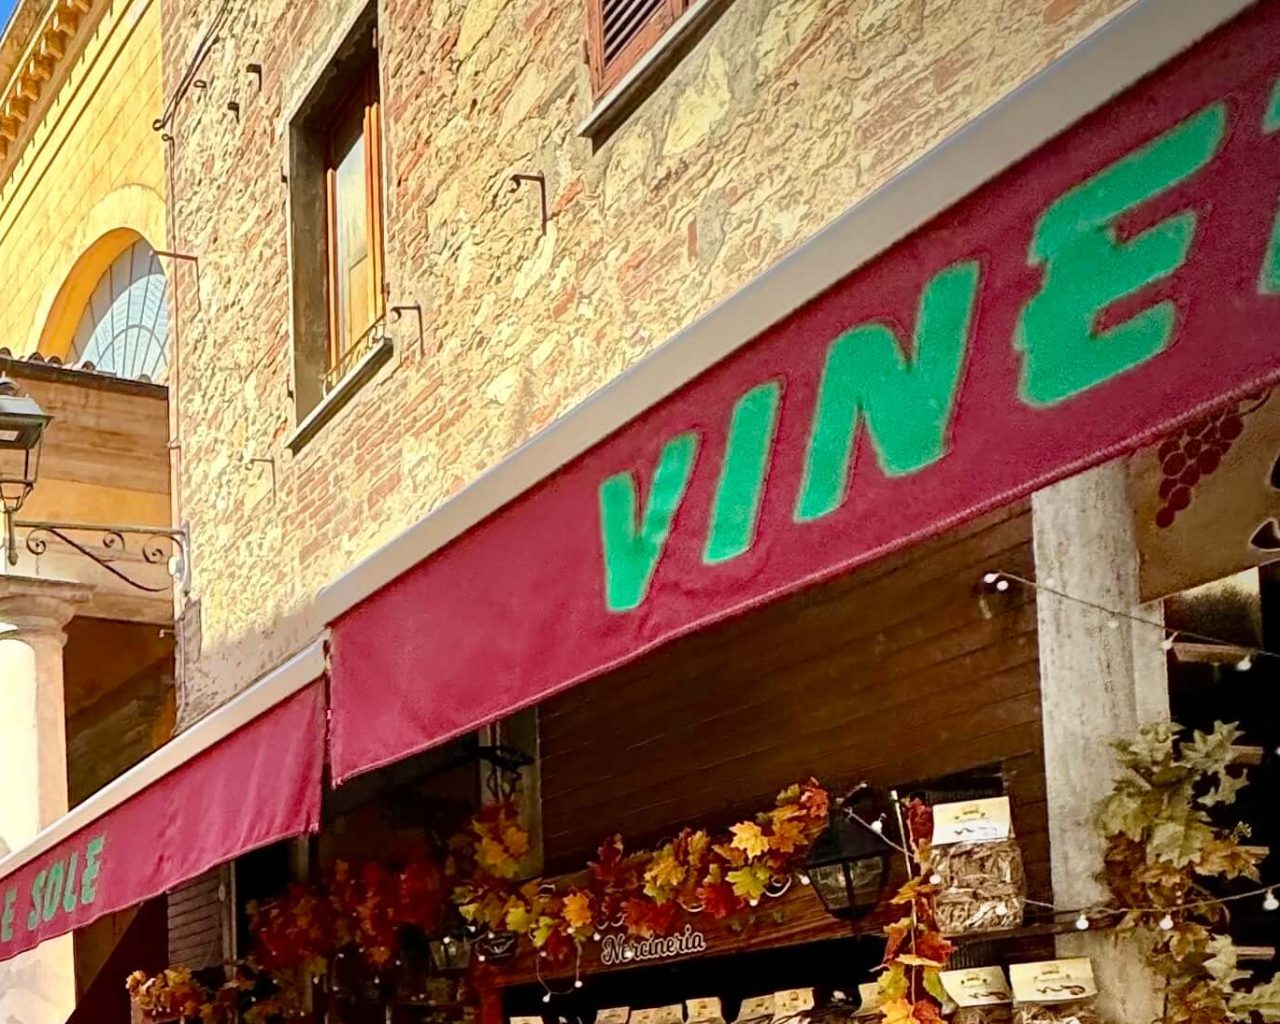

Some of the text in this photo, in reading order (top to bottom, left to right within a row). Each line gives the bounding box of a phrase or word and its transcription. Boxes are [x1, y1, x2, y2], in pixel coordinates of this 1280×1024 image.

[599, 74, 1280, 613] VINE
[1, 886, 18, 943] E
[28, 834, 106, 931] SOLE
[601, 923, 707, 966] Norcineria
